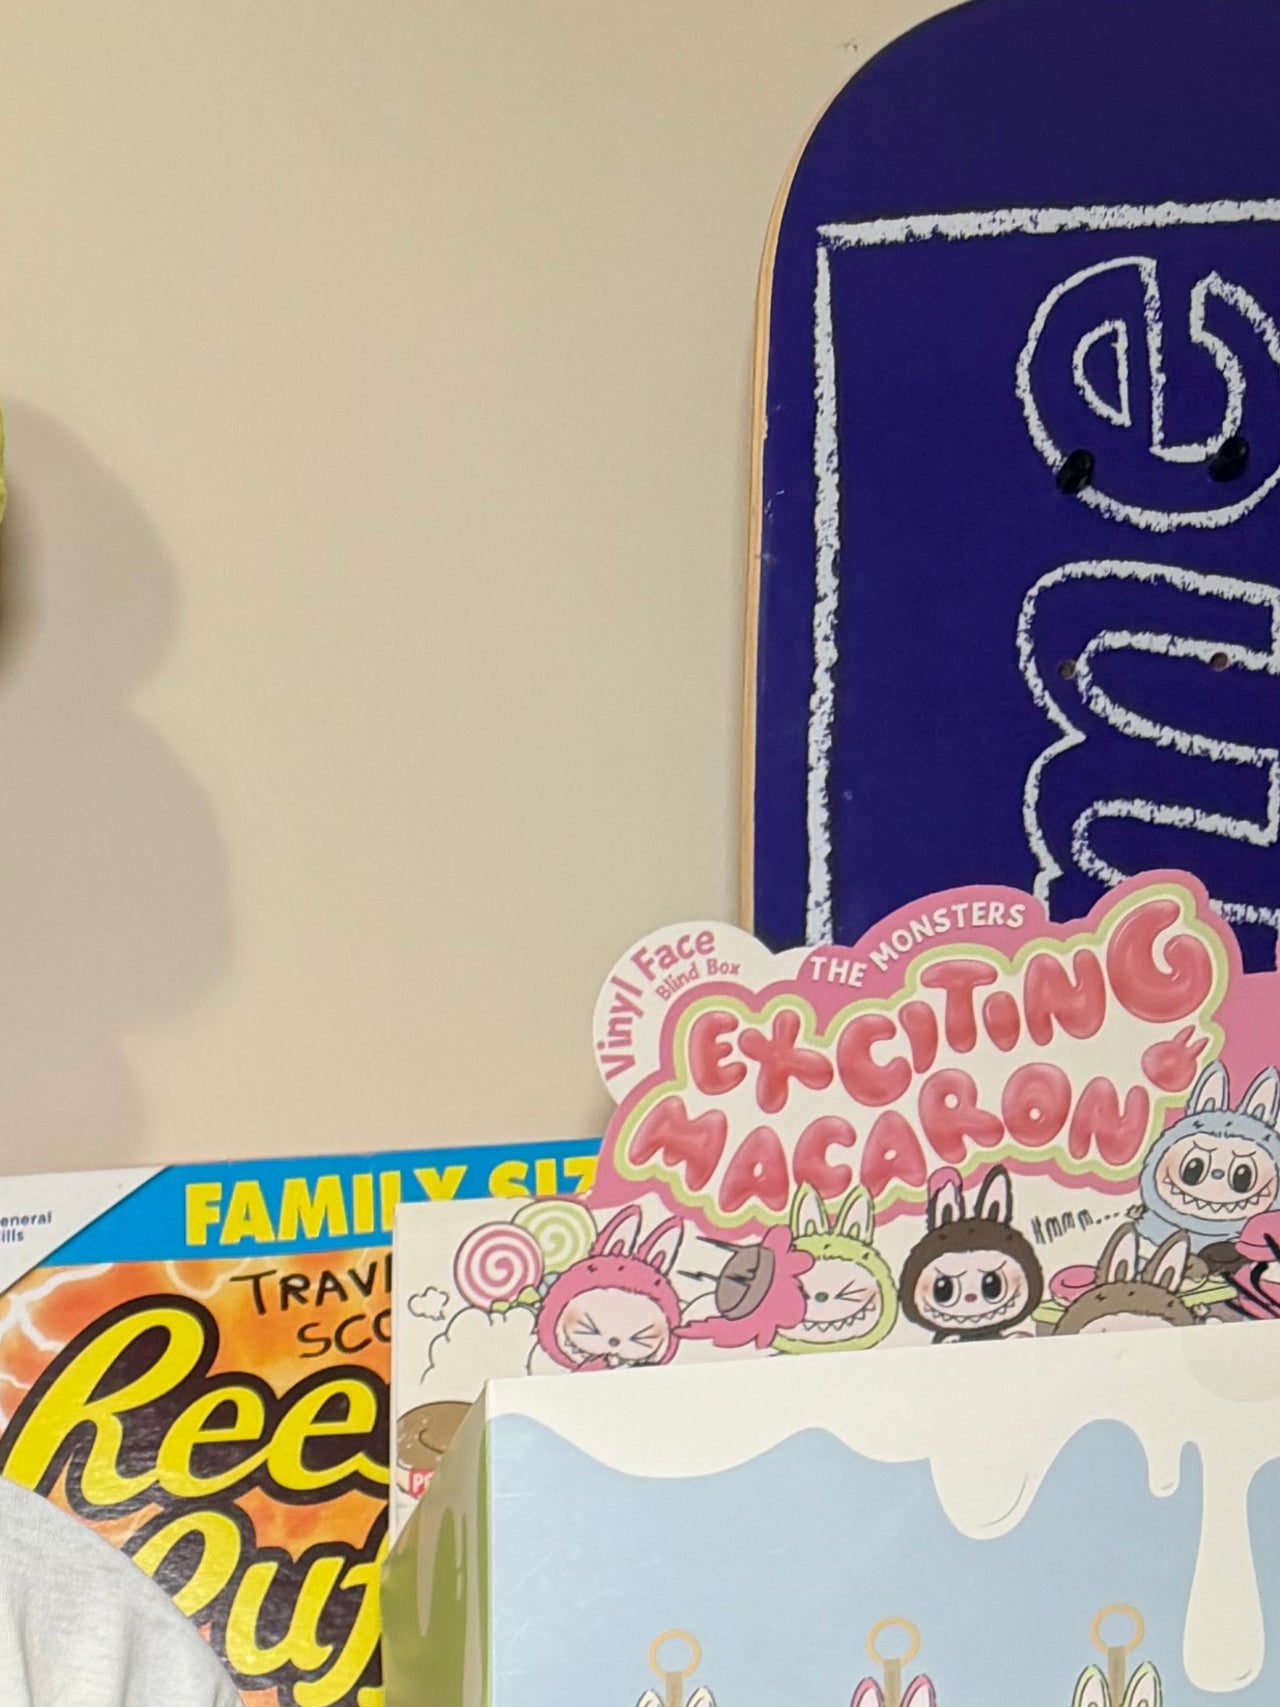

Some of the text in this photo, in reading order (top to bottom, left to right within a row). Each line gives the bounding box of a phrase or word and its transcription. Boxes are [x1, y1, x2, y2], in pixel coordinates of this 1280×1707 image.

[655, 957, 742, 1003] Blind Box
[809, 901, 1027, 989] THE MONSTERS
[596, 929, 717, 1082] Vinyl Face
[687, 899, 1212, 1115] EXCITING
[628, 1060, 1149, 1214] MACARON
[229, 1252, 393, 1316] TRAVI
